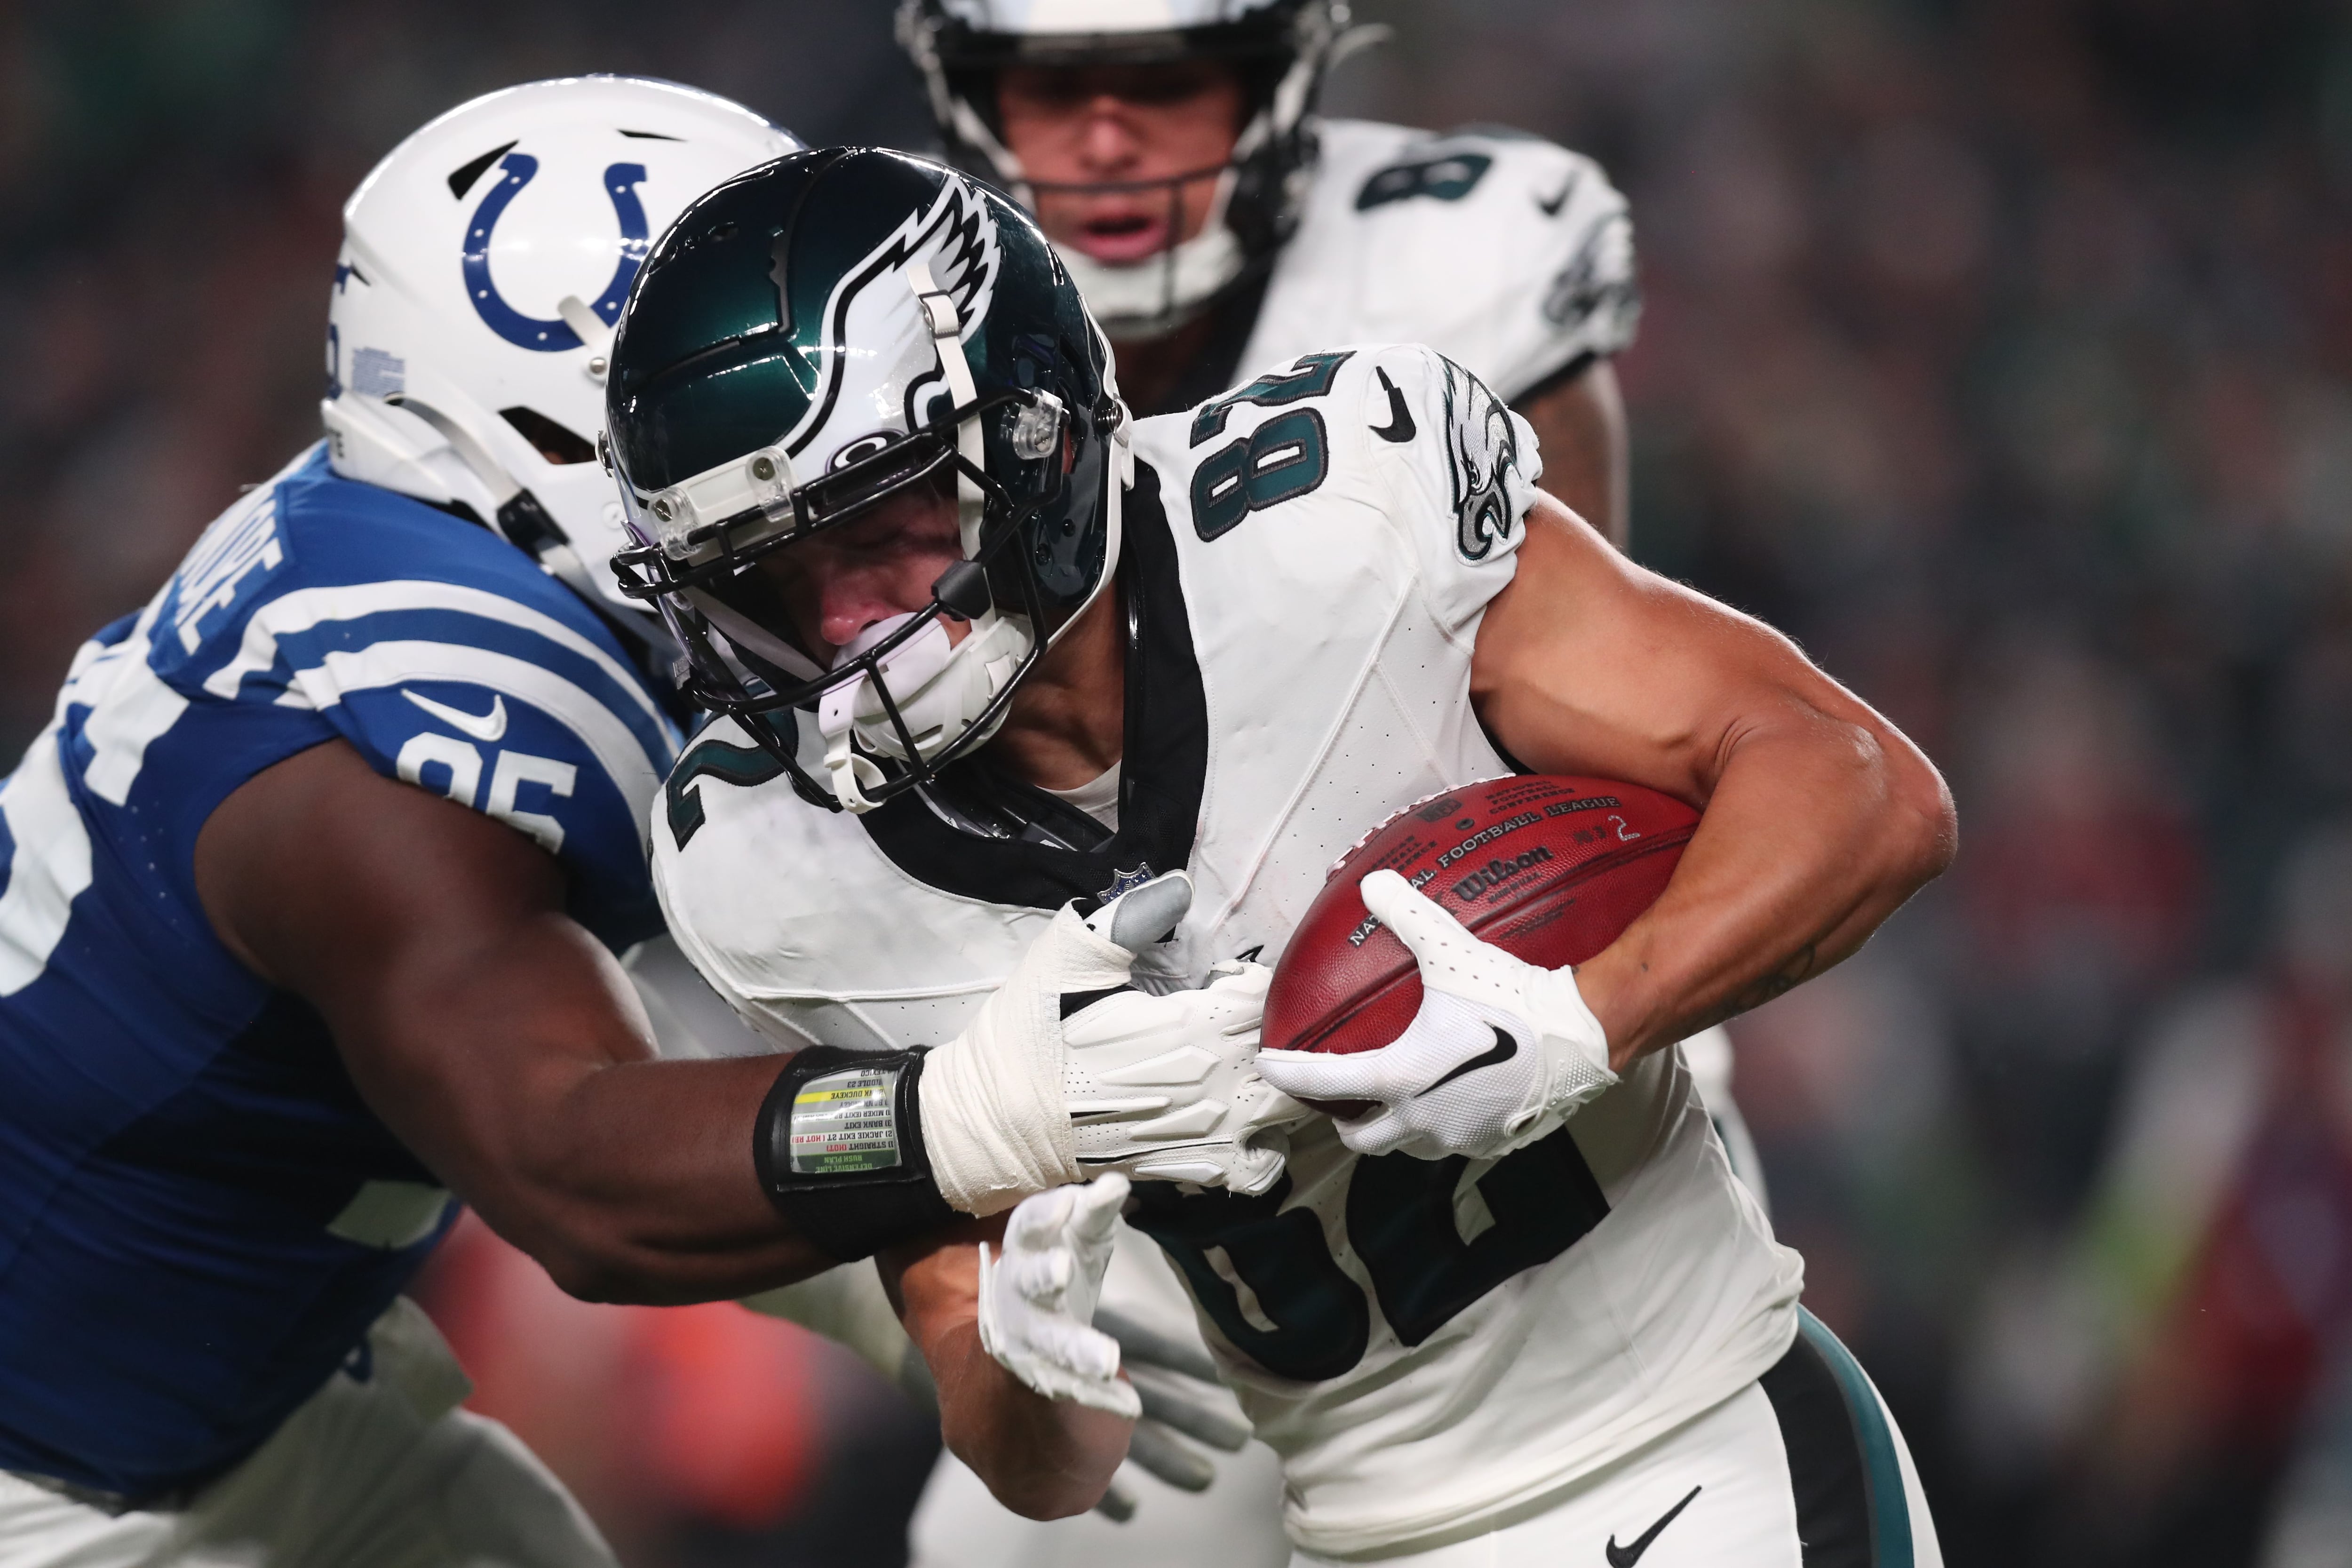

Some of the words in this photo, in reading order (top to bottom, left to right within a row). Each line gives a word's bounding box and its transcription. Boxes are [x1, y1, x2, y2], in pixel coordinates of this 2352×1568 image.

[1189, 349, 1358, 543] 82
[1607, 814, 1641, 841] 2
[1349, 868, 1436, 946] NATAL
[1438, 812, 1541, 868] FOOTBALL
[1545, 797, 1621, 817] LEAGUE
[1450, 845, 1554, 901] Wilson
[844, 1121, 861, 1130] EXIT
[839, 1132, 856, 1140] EXIT
[858, 1130, 882, 1139] JACKIE
[826, 1144, 847, 1152] (HOT)
[849, 1141, 886, 1150] STRAIGHT
[816, 1164, 834, 1173] LINE
[834, 1163, 873, 1172] DEFENSIVE
